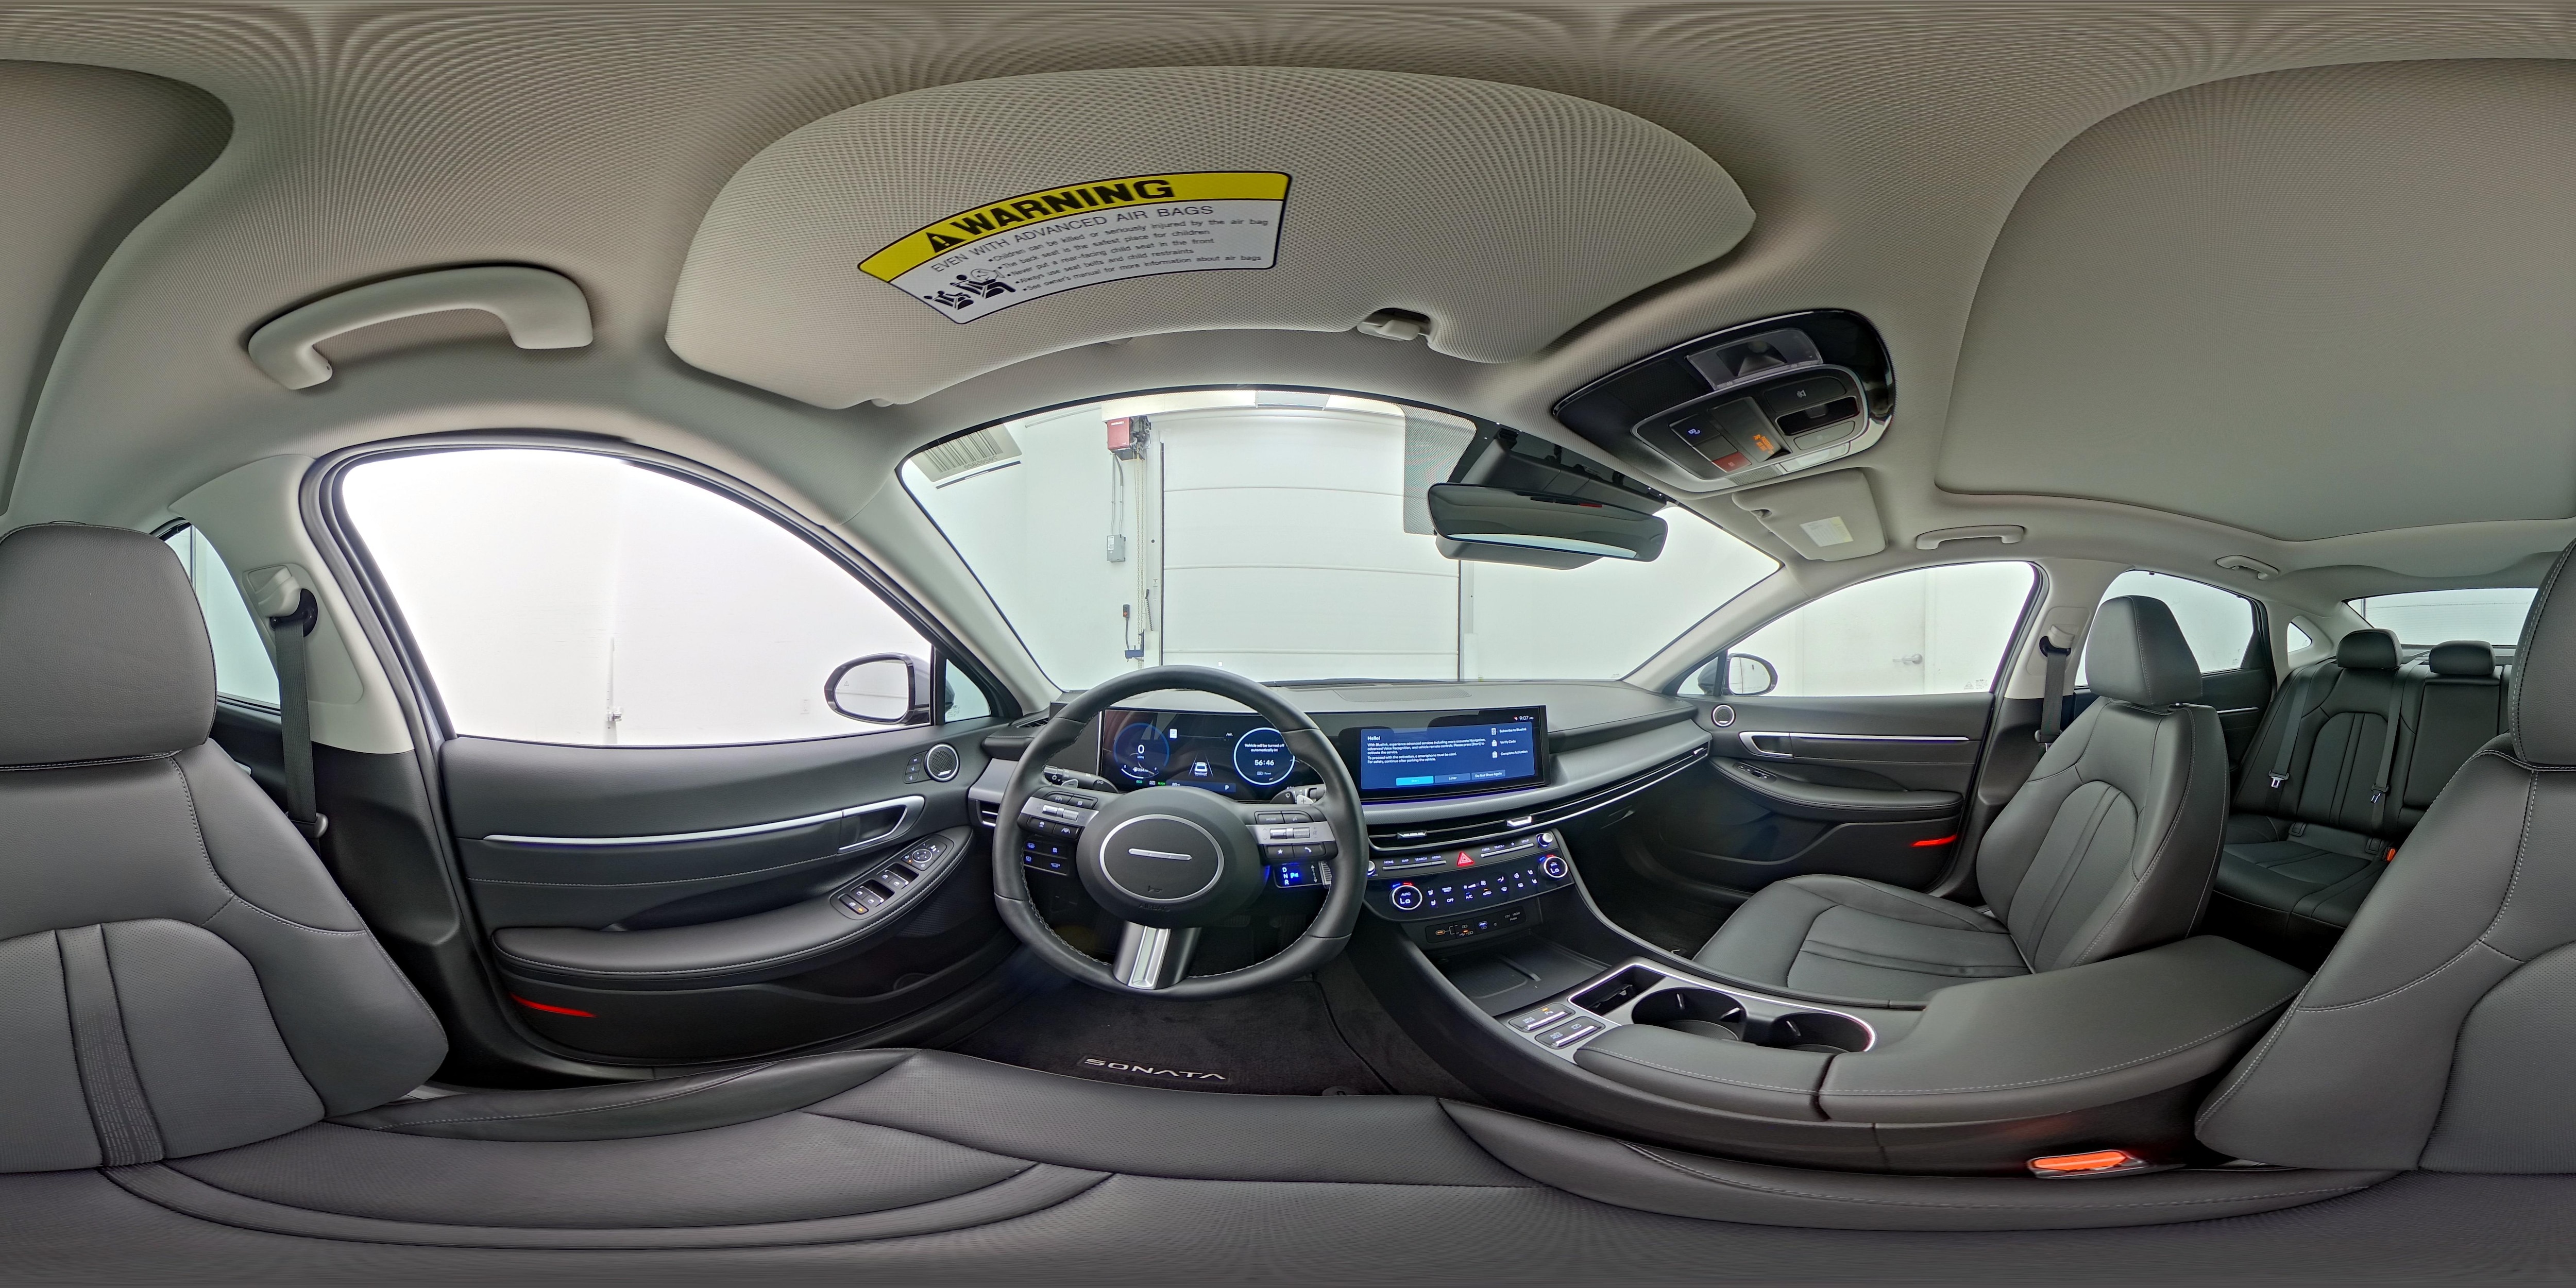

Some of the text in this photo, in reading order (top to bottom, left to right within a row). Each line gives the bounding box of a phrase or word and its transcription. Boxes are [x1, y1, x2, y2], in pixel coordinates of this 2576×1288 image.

[950, 179, 1175, 235] WARNING
[931, 206, 1214, 273] EVEN WITH ADVANCED AIR BAGS
[993, 249, 1026, 261] Children
[1060, 234, 1086, 243] killed
[1104, 224, 1146, 235] seriously
[1150, 221, 1186, 229] injured
[1019, 255, 1040, 264] back
[1041, 249, 1061, 258] seat
[1092, 238, 1121, 247] safest
[1124, 234, 1149, 243] place
[1011, 267, 1033, 276] Never
[1061, 250, 1107, 263] rear-facing
[1020, 274, 1045, 283] Always
[1151, 248, 1194, 257] restraints
[1044, 276, 1072, 286] owner's
[1072, 269, 1101, 279] manual
[1144, 257, 1192, 267] information
[1138, 744, 1145, 754] 0
[1084, 1058, 1226, 1080] SONATA
